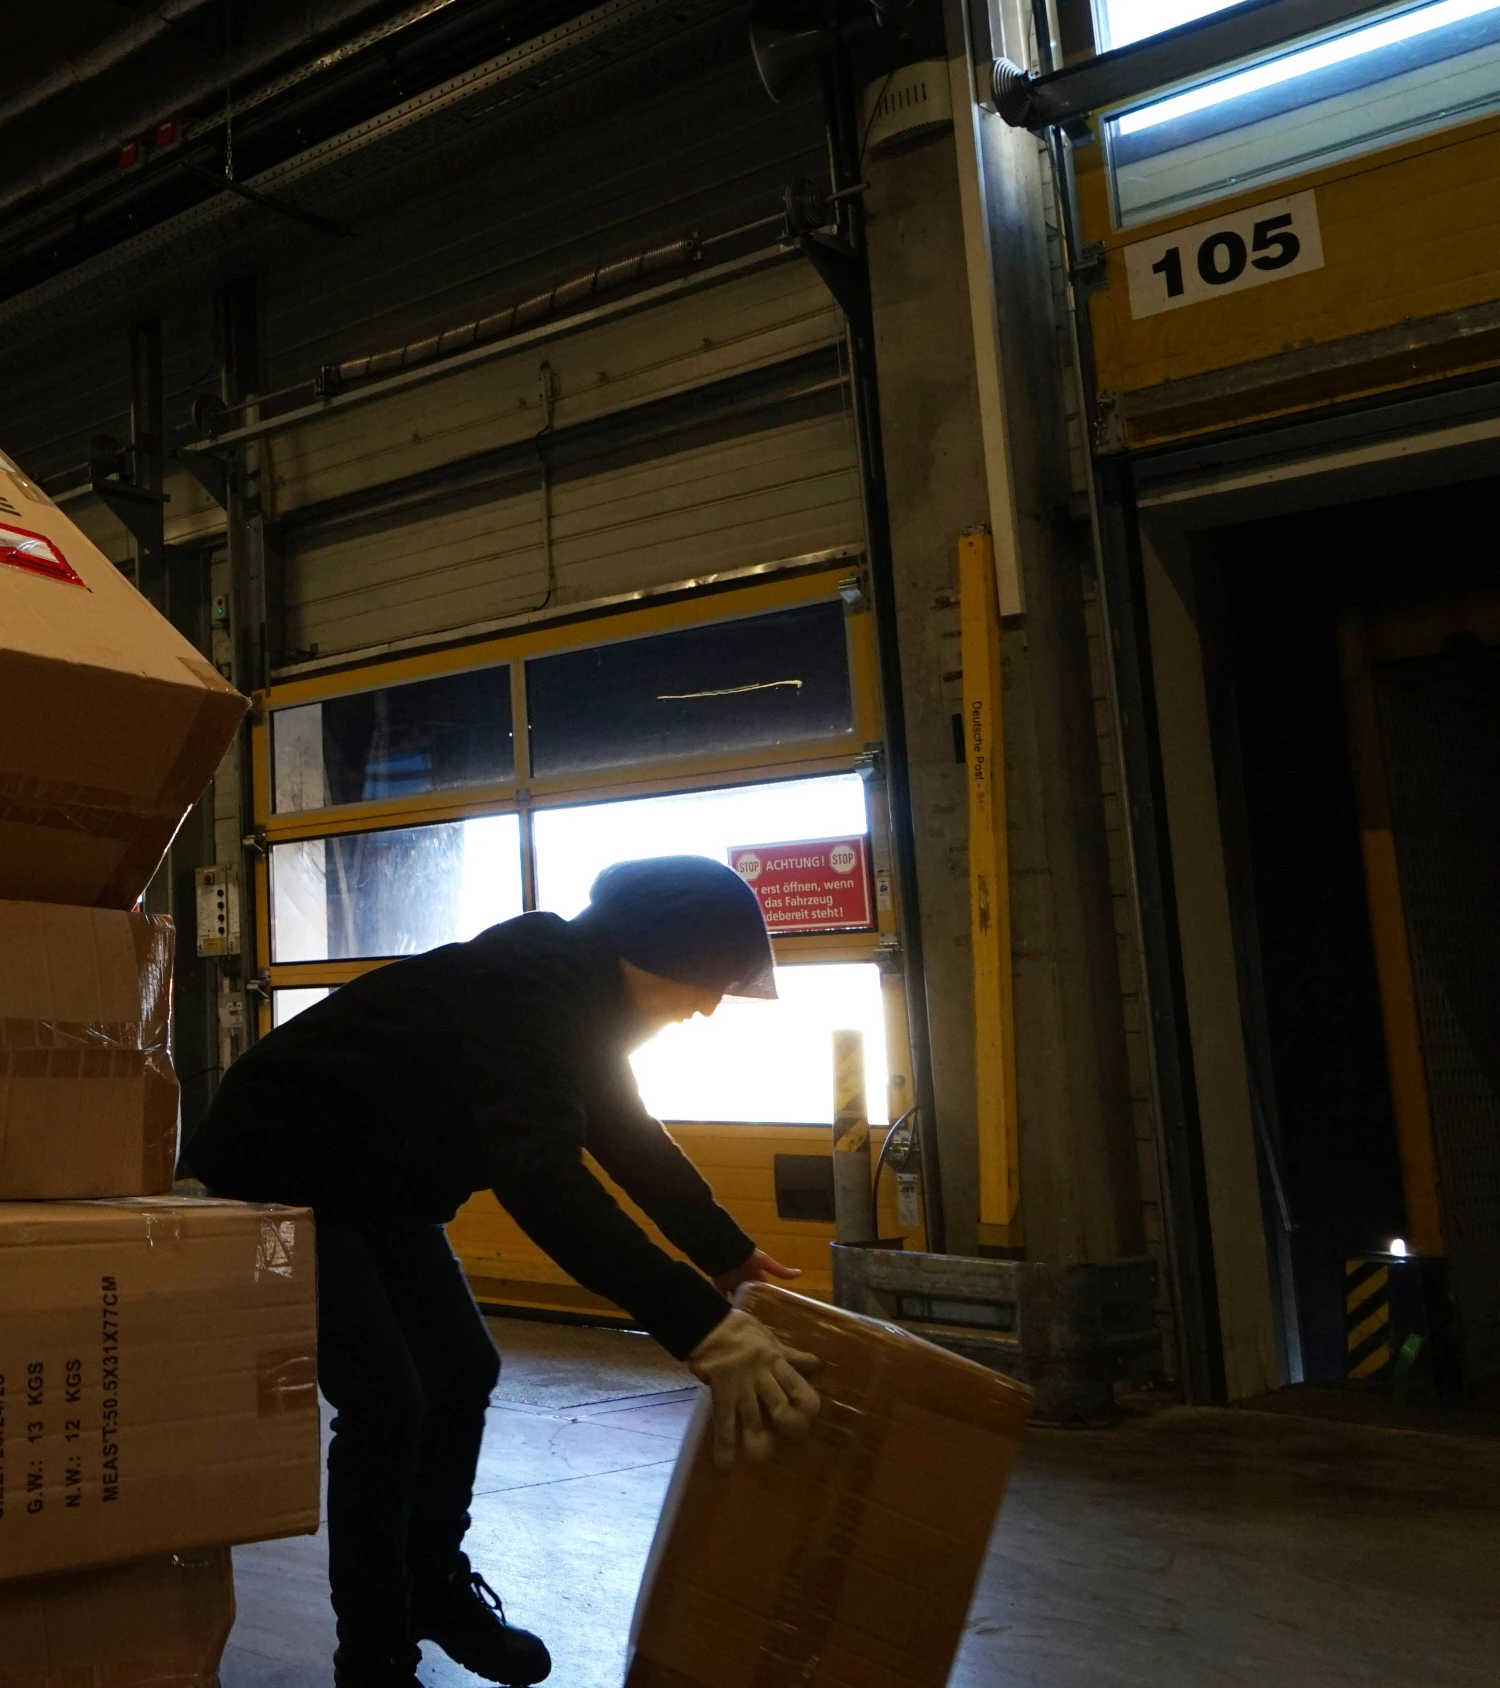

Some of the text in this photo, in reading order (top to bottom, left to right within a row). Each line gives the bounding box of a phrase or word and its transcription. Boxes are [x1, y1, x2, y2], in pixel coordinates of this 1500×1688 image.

[1152, 213, 1300, 298] 105
[972, 701, 984, 753] Deutsche
[974, 756, 985, 781] Post
[740, 861, 759, 873] STOP
[766, 856, 825, 871] ACHTUNG!
[832, 853, 854, 866] STOP
[761, 884, 780, 895] erst
[783, 881, 821, 893] öffnen,
[824, 880, 854, 890] wenn
[765, 895, 833, 908] das Fahrzeug
[811, 907, 844, 920] steht!
[27, 1362, 44, 1514] G.W.: 13 KGS
[65, 1358, 82, 1508] N.W.: 12 KGS
